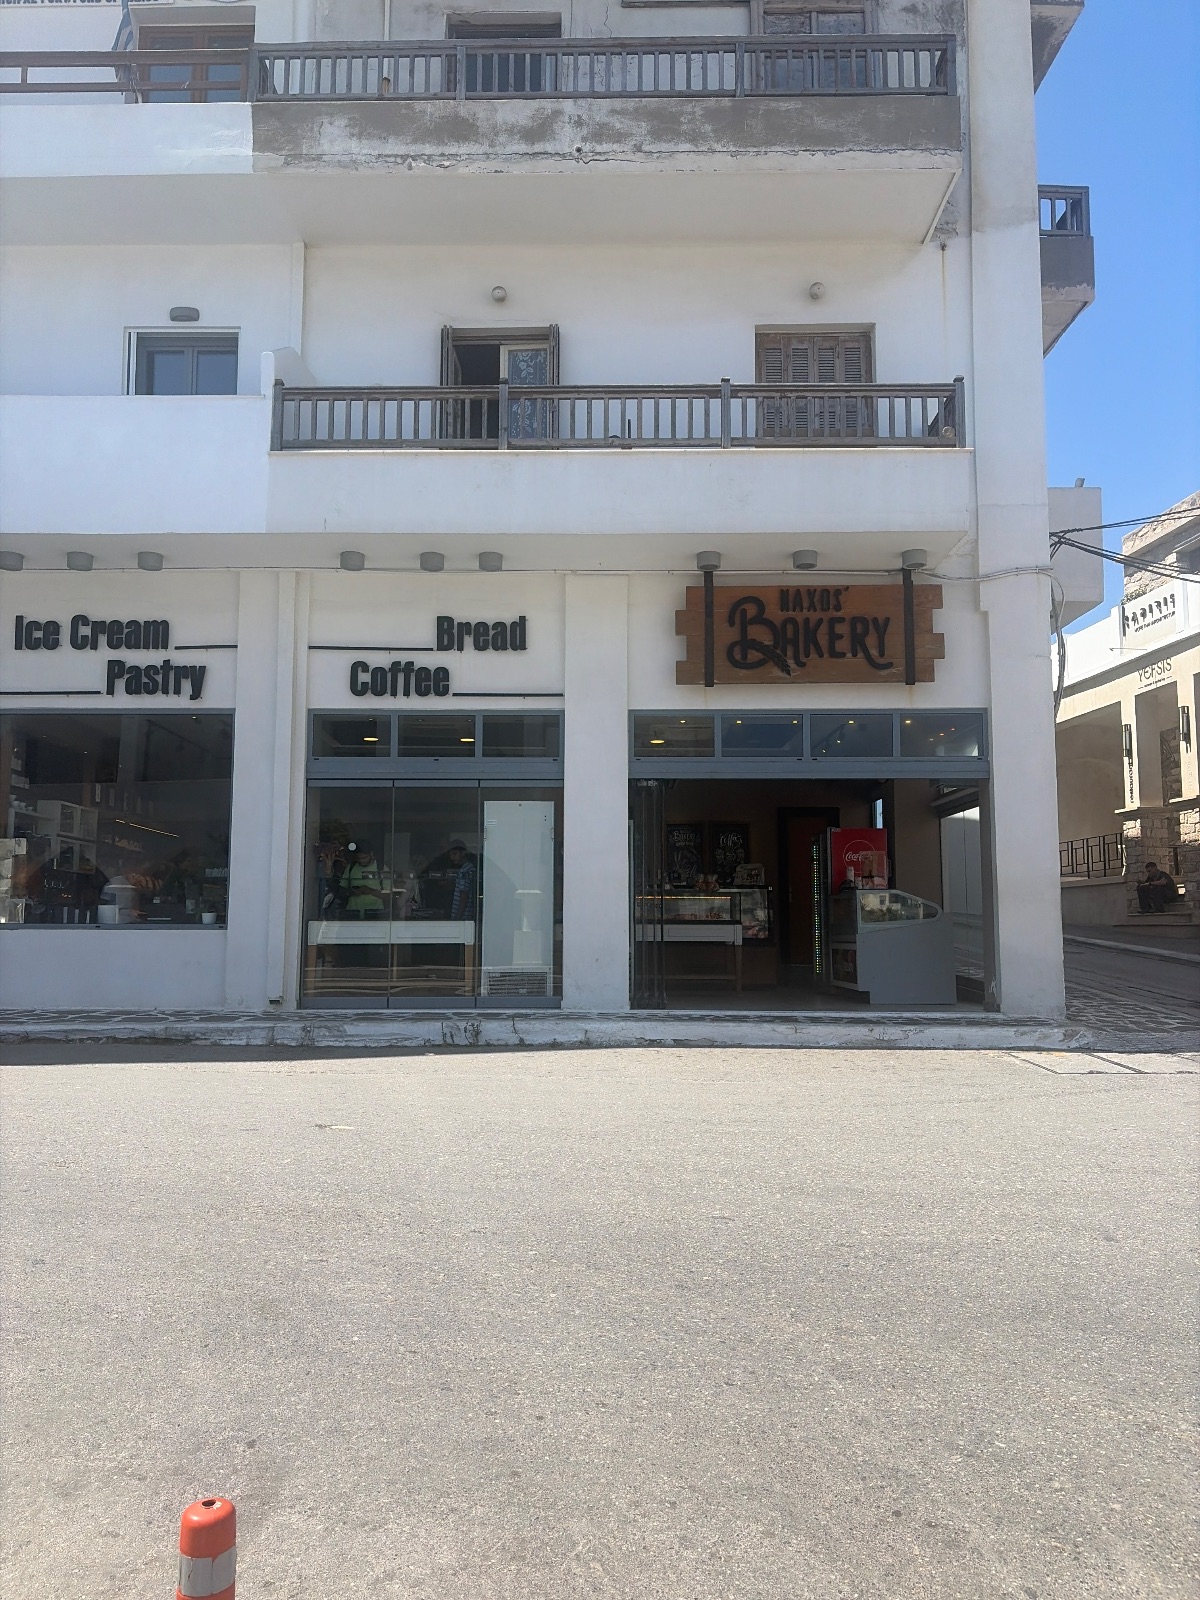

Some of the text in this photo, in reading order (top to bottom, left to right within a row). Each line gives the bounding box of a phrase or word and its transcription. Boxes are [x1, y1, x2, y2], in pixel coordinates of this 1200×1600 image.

[780, 587, 849, 612] NAXOS'
[15, 614, 169, 650] Ice Cream
[437, 616, 527, 651] Bread
[727, 596, 894, 677] BAKERY
[106, 659, 206, 700] Pastry
[350, 661, 450, 697] Coffee
